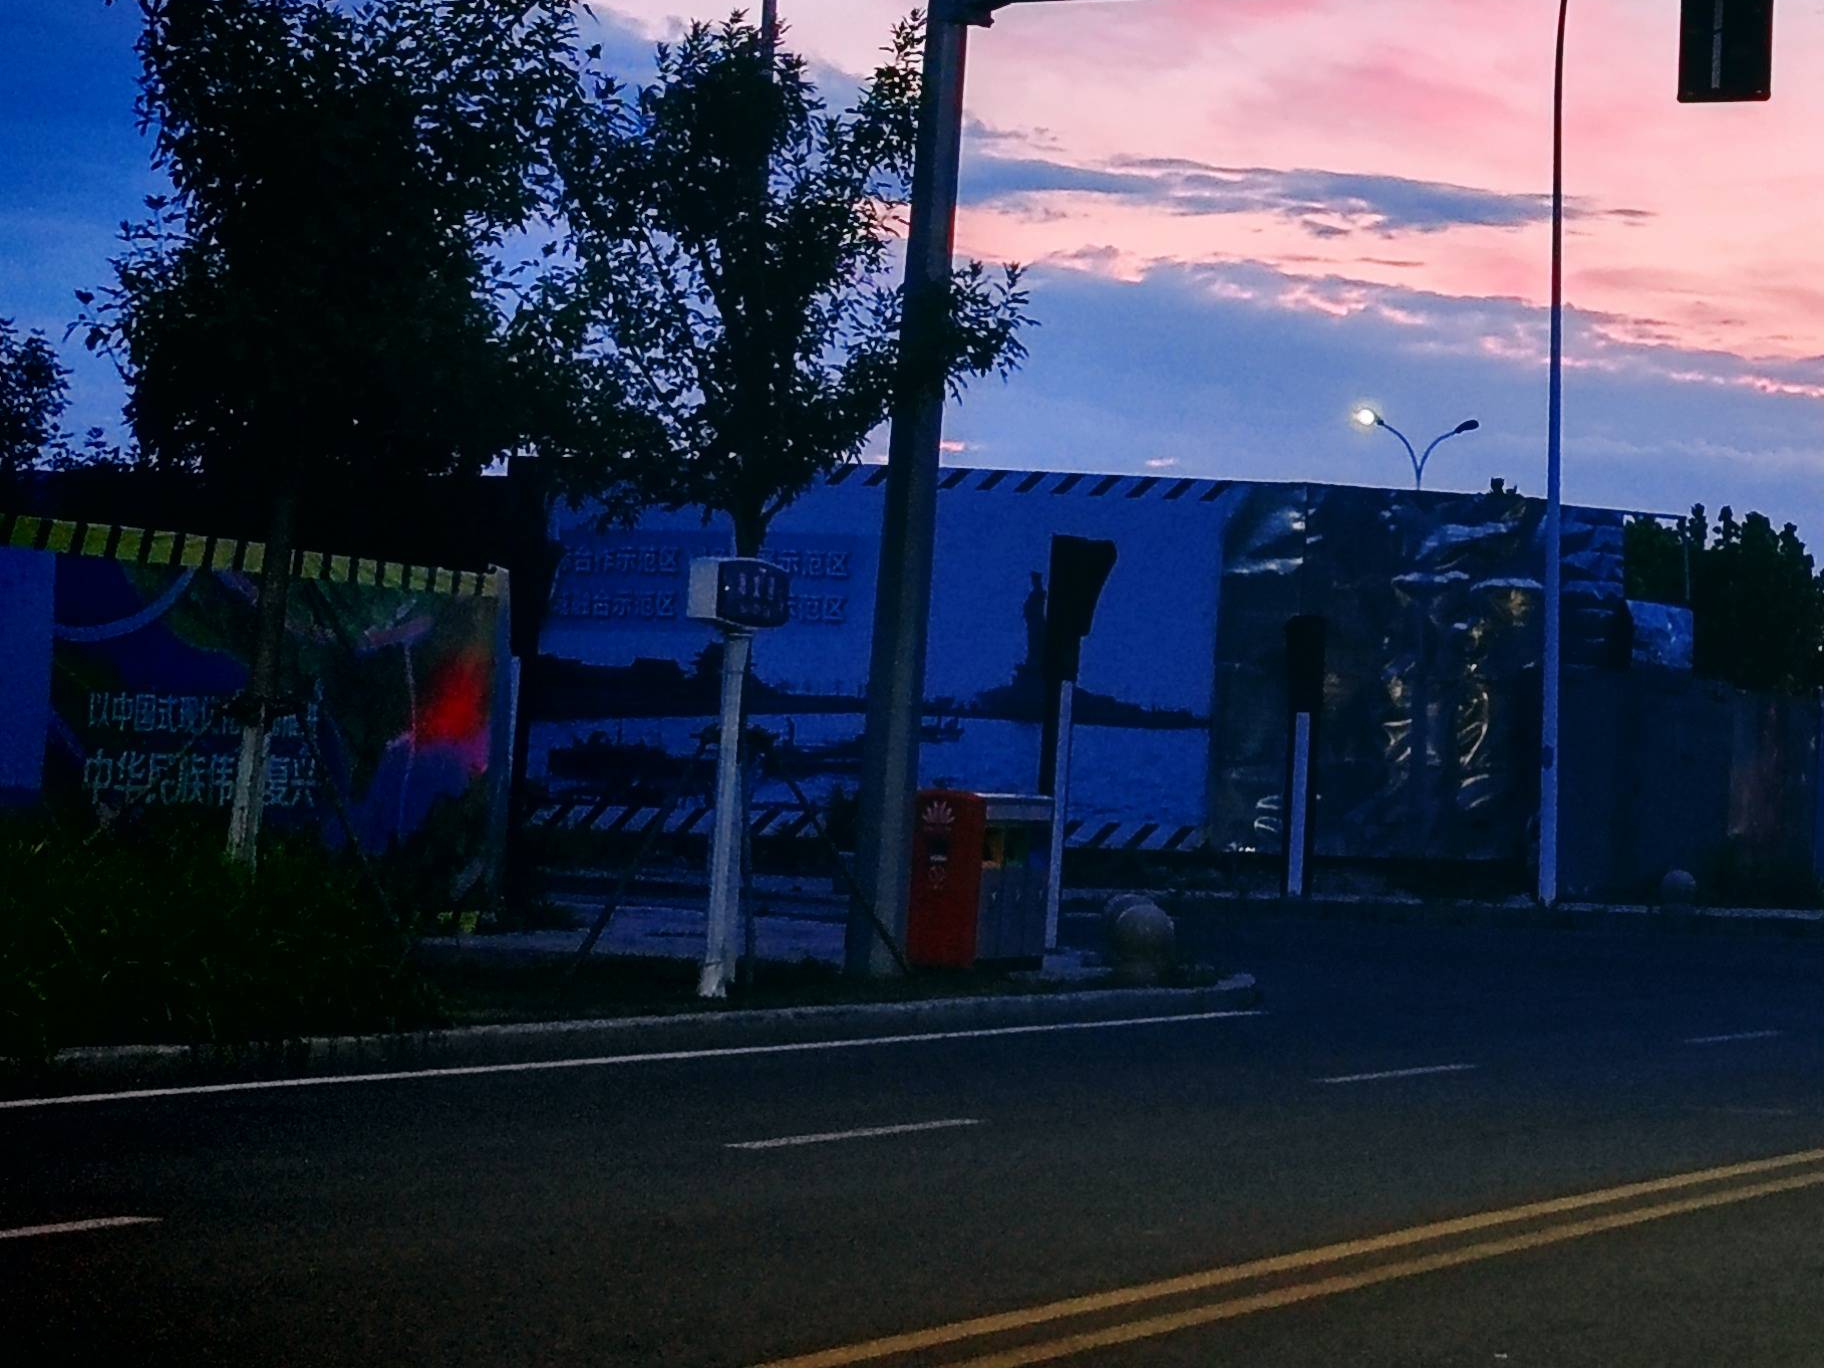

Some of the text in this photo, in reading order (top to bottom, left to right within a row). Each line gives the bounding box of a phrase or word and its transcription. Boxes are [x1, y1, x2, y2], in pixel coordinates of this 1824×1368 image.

[83, 747, 319, 809] 中华民族伟复兴
